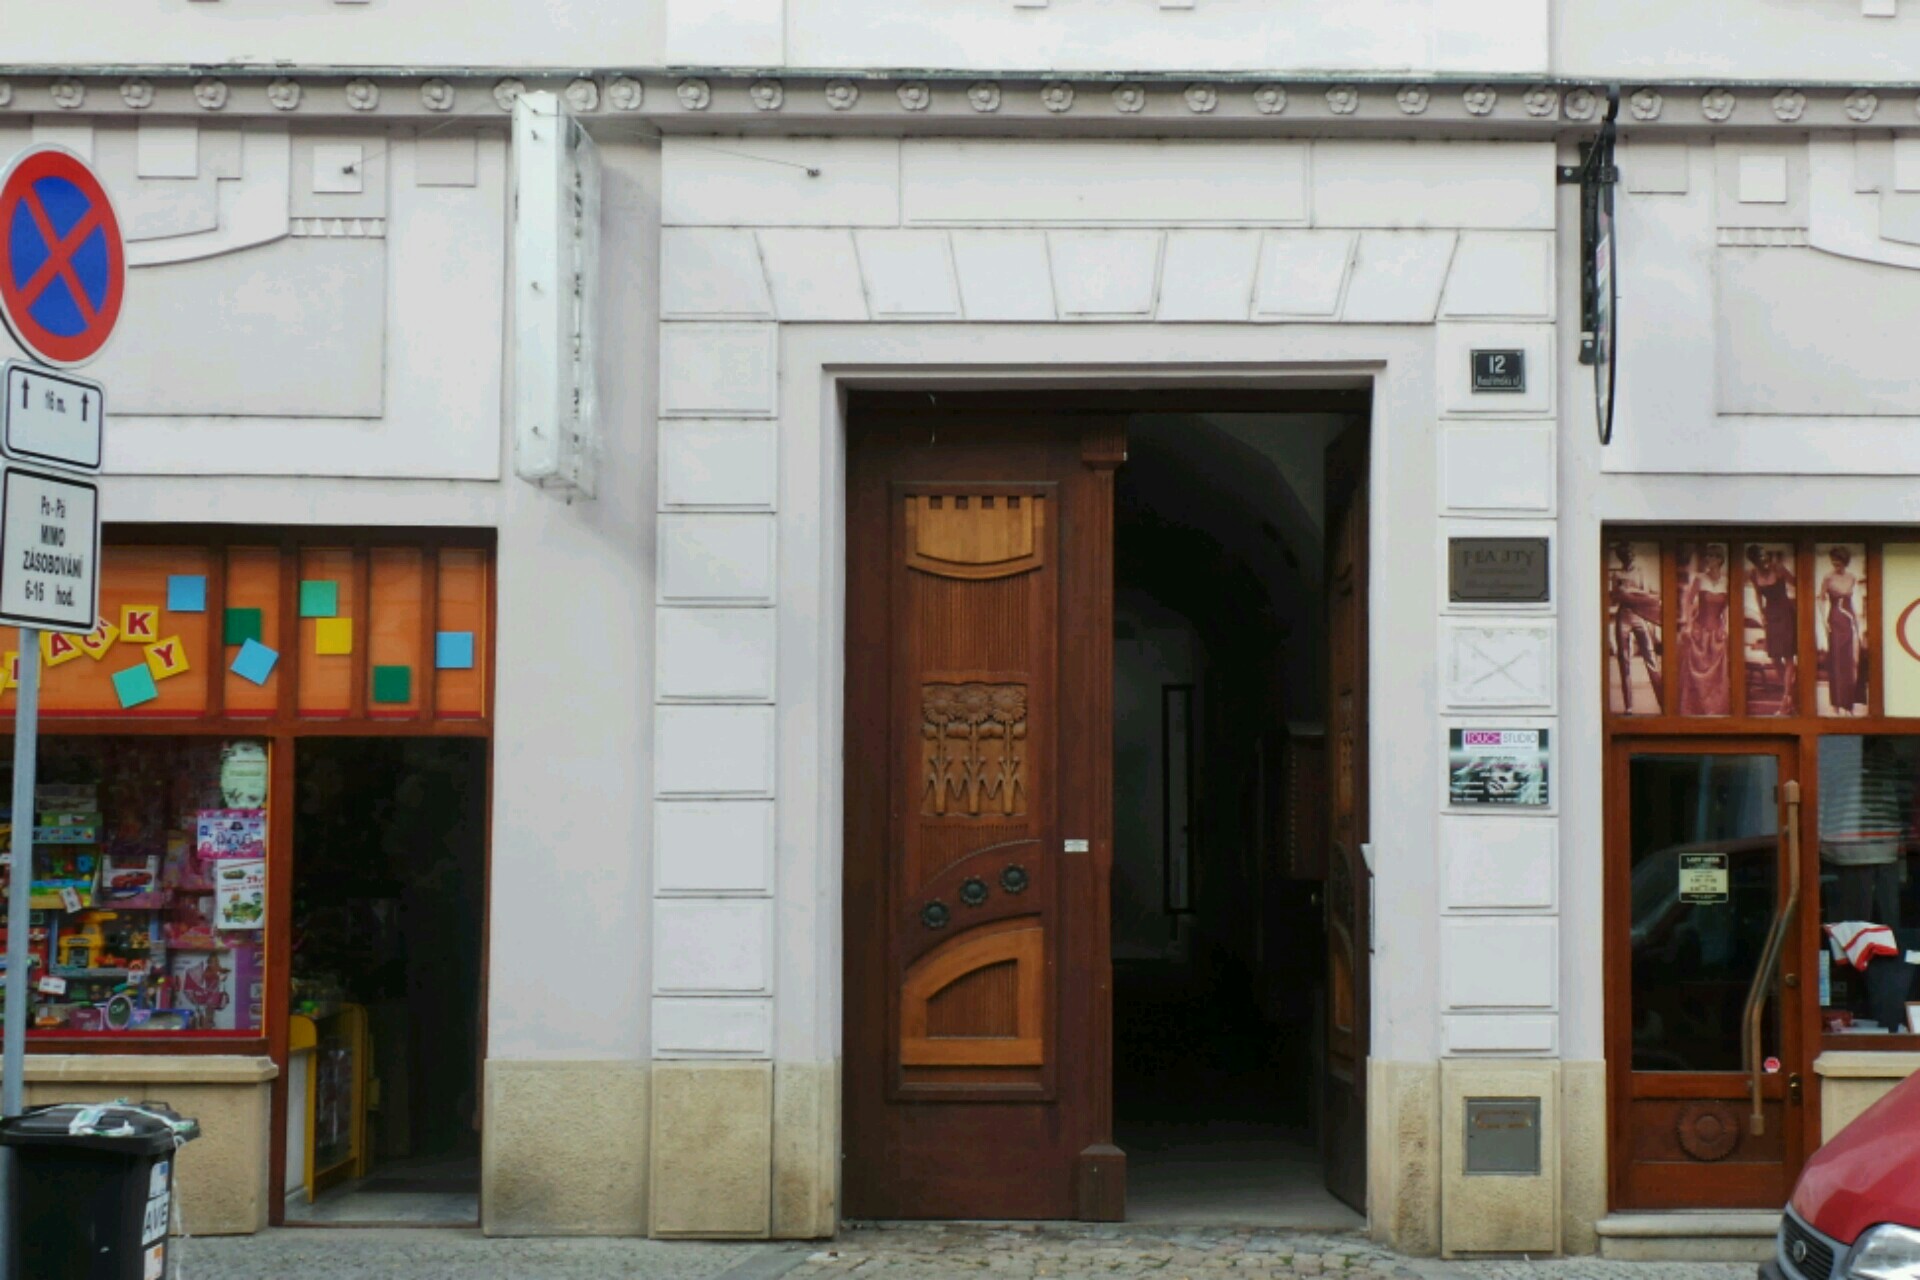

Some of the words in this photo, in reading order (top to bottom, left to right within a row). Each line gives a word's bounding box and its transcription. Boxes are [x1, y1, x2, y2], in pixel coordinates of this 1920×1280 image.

[1488, 355, 1506, 374] 12
[41, 525, 66, 547] MIMO
[23, 547, 83, 578] ZÁSOBOVÁNÍ
[56, 584, 75, 607] hod.
[1502, 732, 1538, 744] STUDIO
